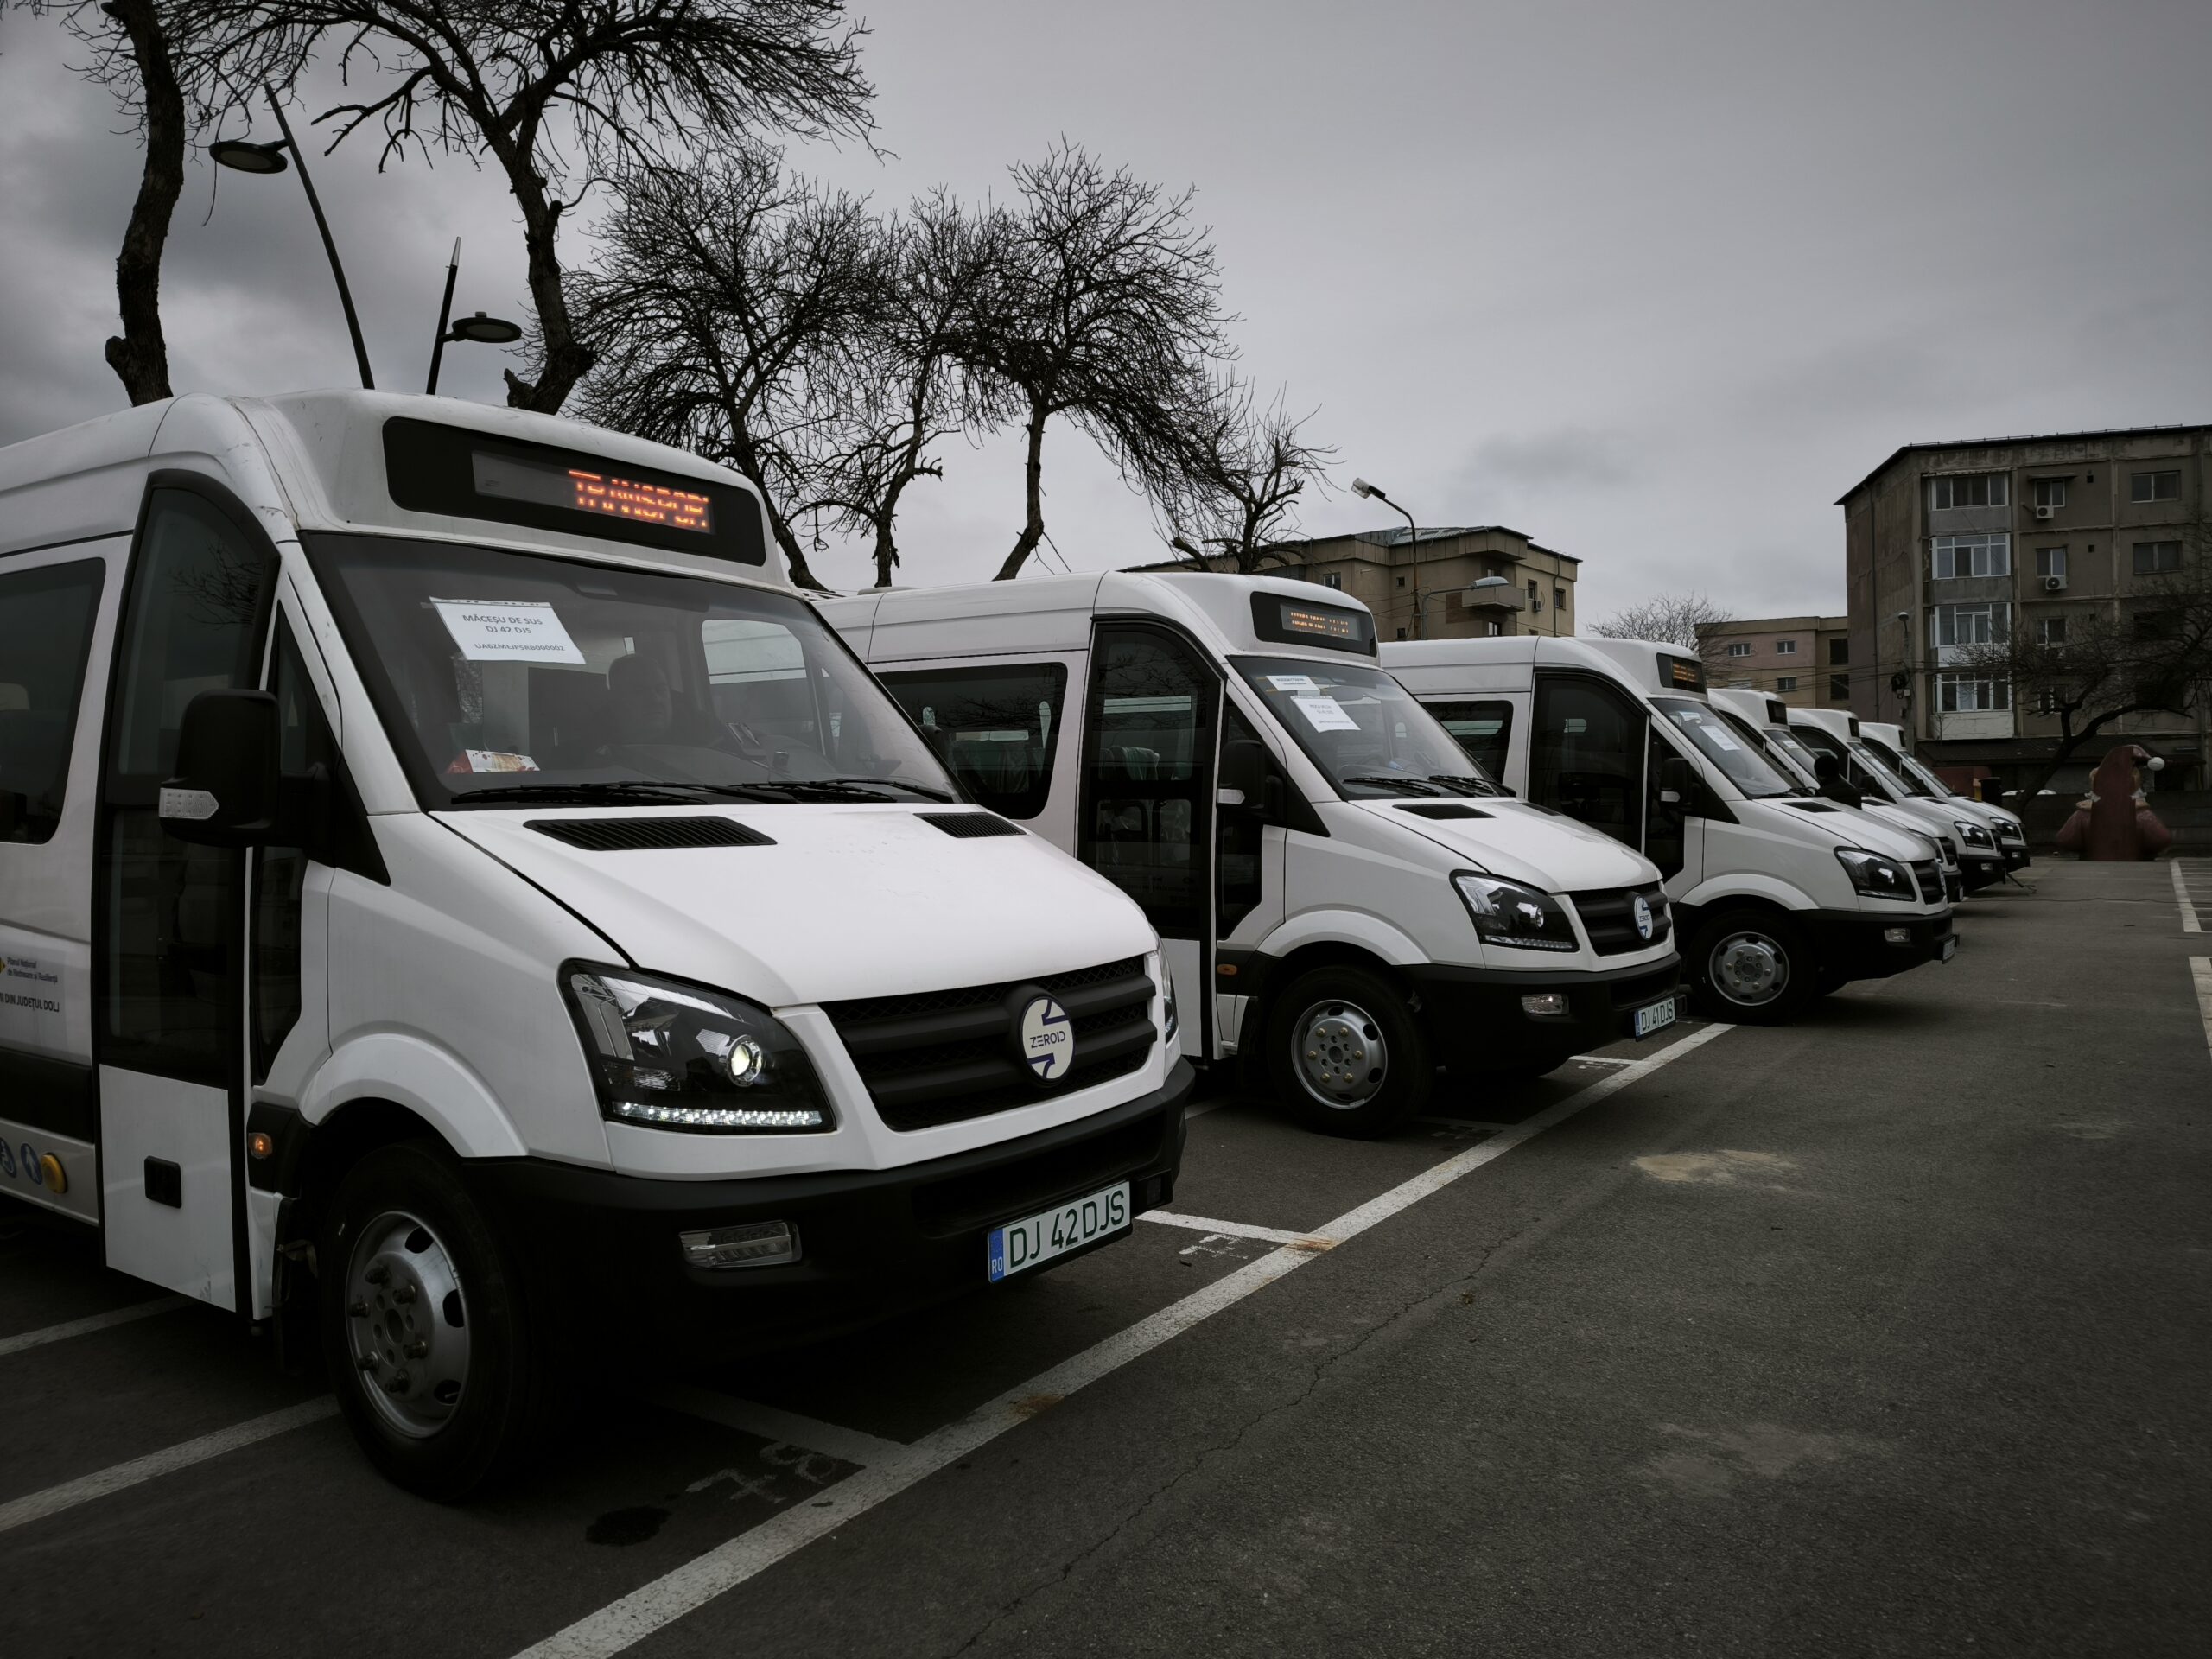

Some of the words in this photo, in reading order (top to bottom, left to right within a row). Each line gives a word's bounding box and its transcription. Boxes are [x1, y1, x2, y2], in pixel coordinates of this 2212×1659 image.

[524, 617, 543, 626] SUS
[5, 993, 16, 1004] DIN
[44, 1000, 60, 1012] DOLJ
[1641, 1009, 1650, 1031] DJ
[1029, 1031, 1065, 1048] ZEROID
[1009, 1221, 1041, 1268] DJ
[991, 1256, 1003, 1274] RO
